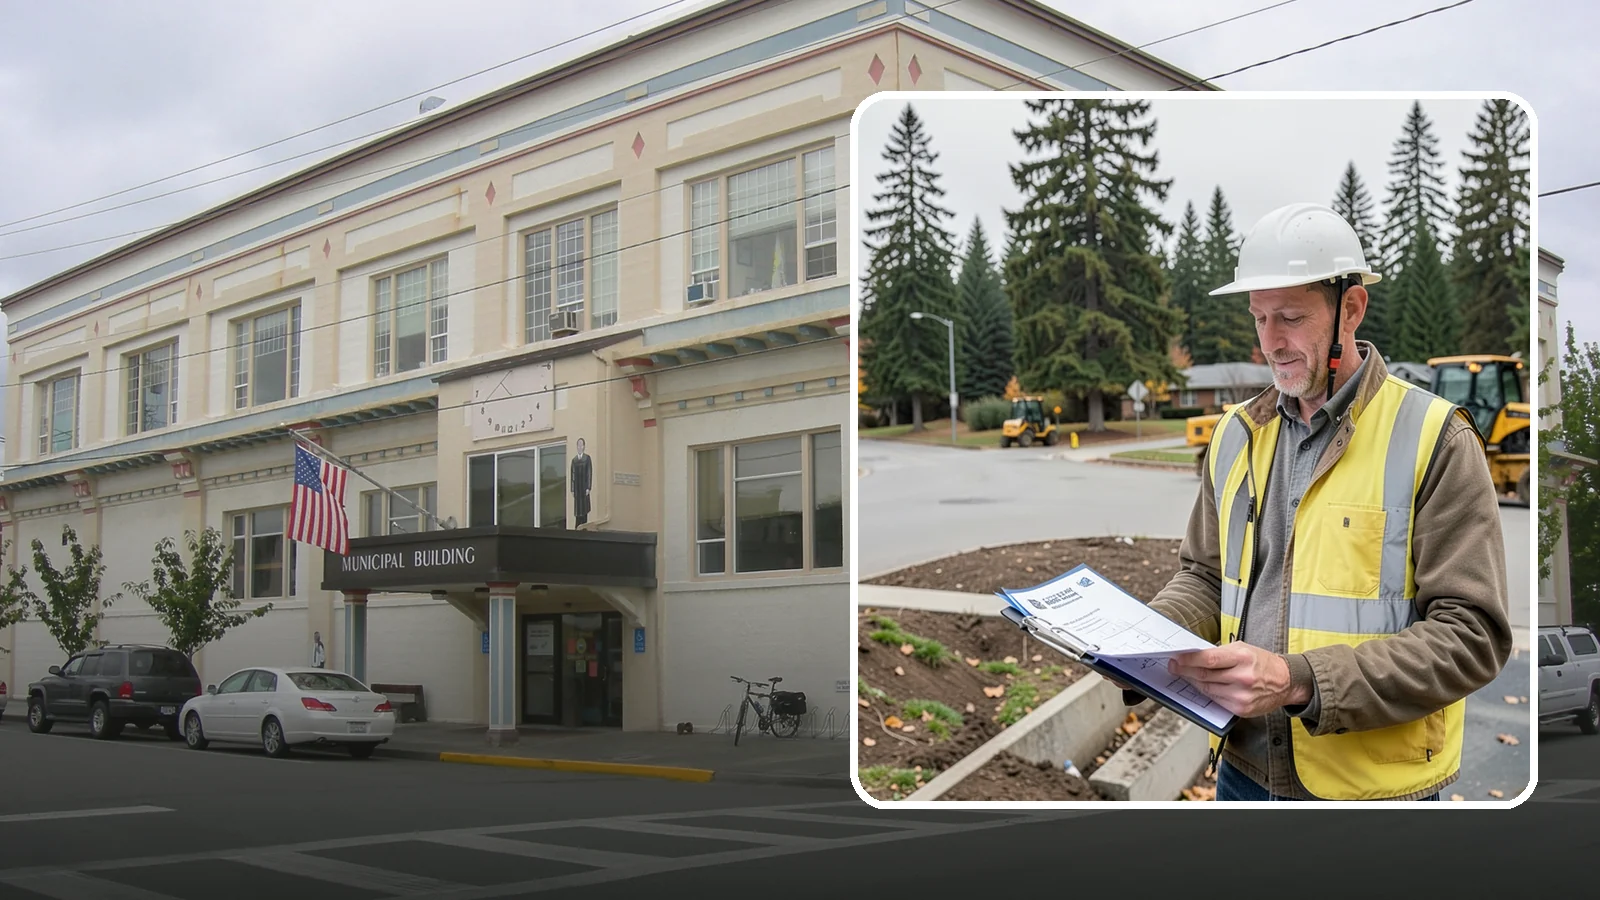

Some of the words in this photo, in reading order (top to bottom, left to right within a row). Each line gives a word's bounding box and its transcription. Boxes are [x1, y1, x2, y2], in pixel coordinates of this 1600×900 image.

[481, 407, 485, 415] 8
[488, 418, 492, 426] 9
[494, 424, 500, 432] 10
[342, 552, 405, 572] MUNICIPAL
[414, 546, 475, 567] BUILDING
